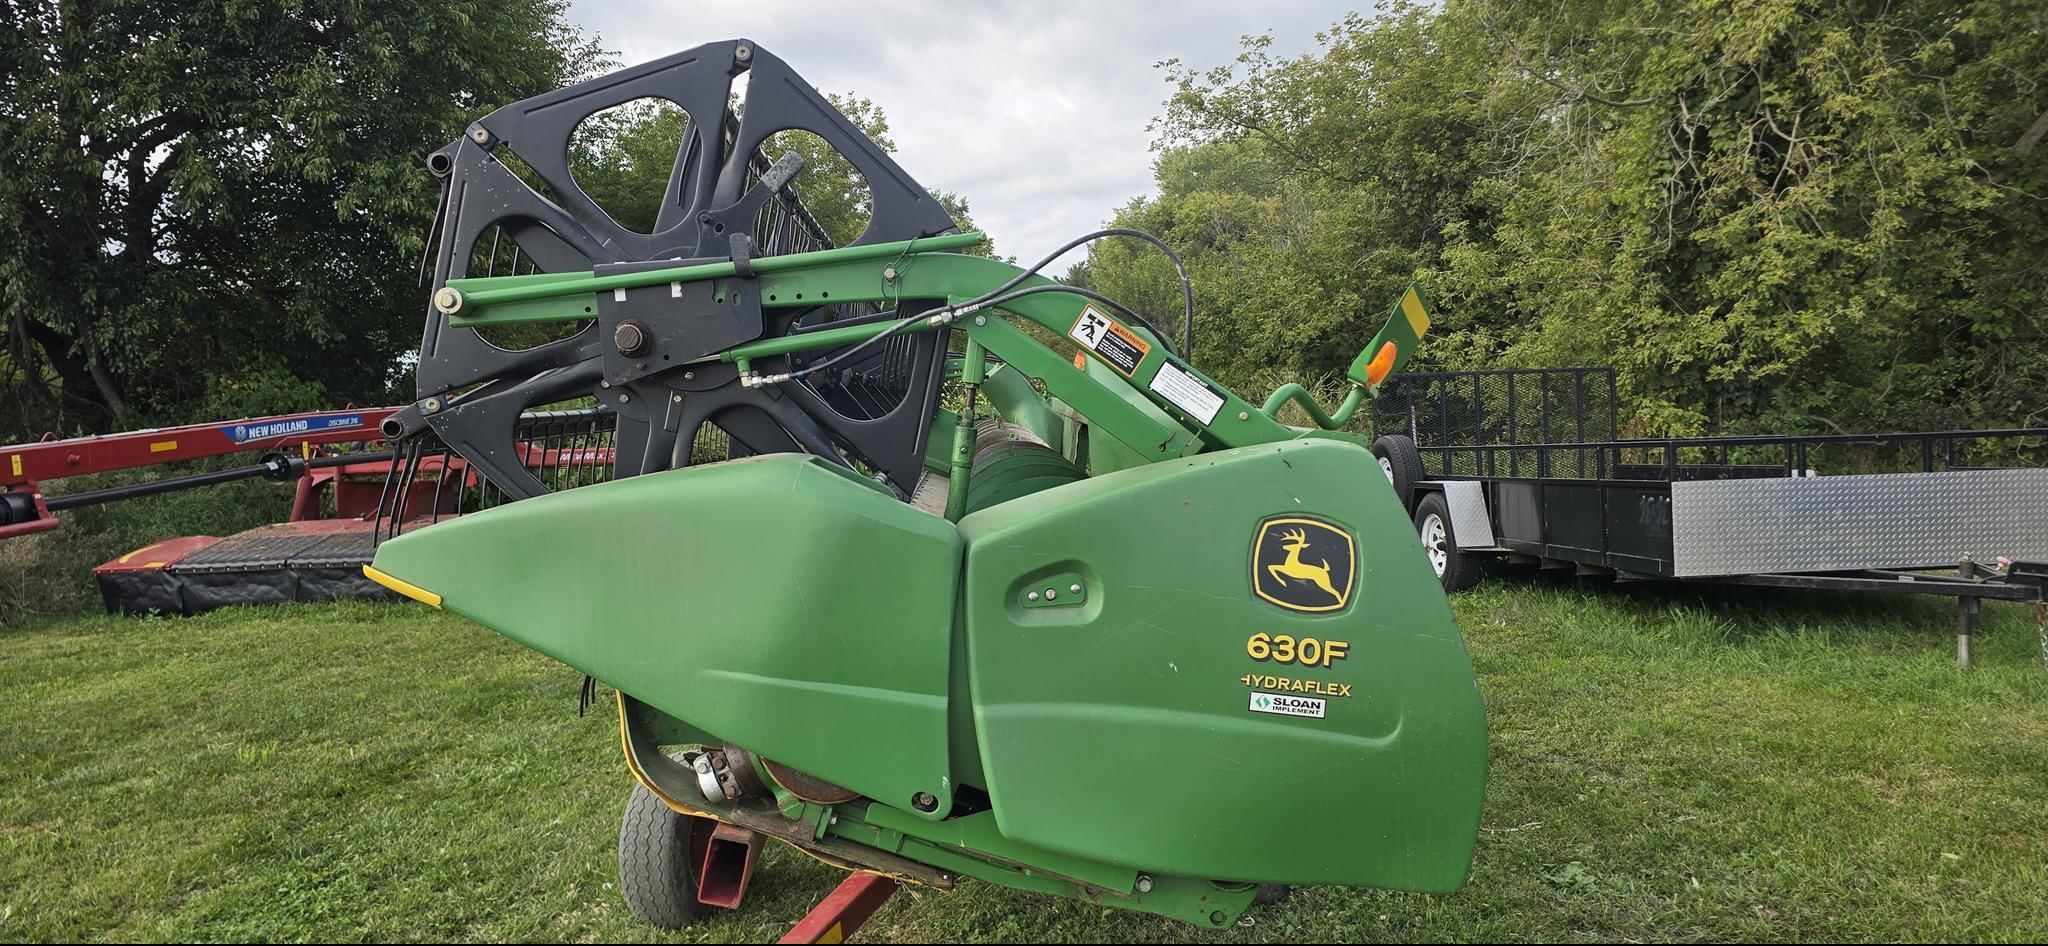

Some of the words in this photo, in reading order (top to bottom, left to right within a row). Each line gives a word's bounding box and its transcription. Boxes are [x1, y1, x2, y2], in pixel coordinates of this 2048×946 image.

[1118, 329, 1146, 350] WARNING
[1185, 371, 1209, 388] IMPORTANT
[249, 427, 269, 439] NEW
[270, 420, 308, 435] HOLLAND
[1246, 631, 1349, 669] 630F
[1272, 705, 1320, 716] IMPLEMENT
[1273, 697, 1321, 710] SLOAN
